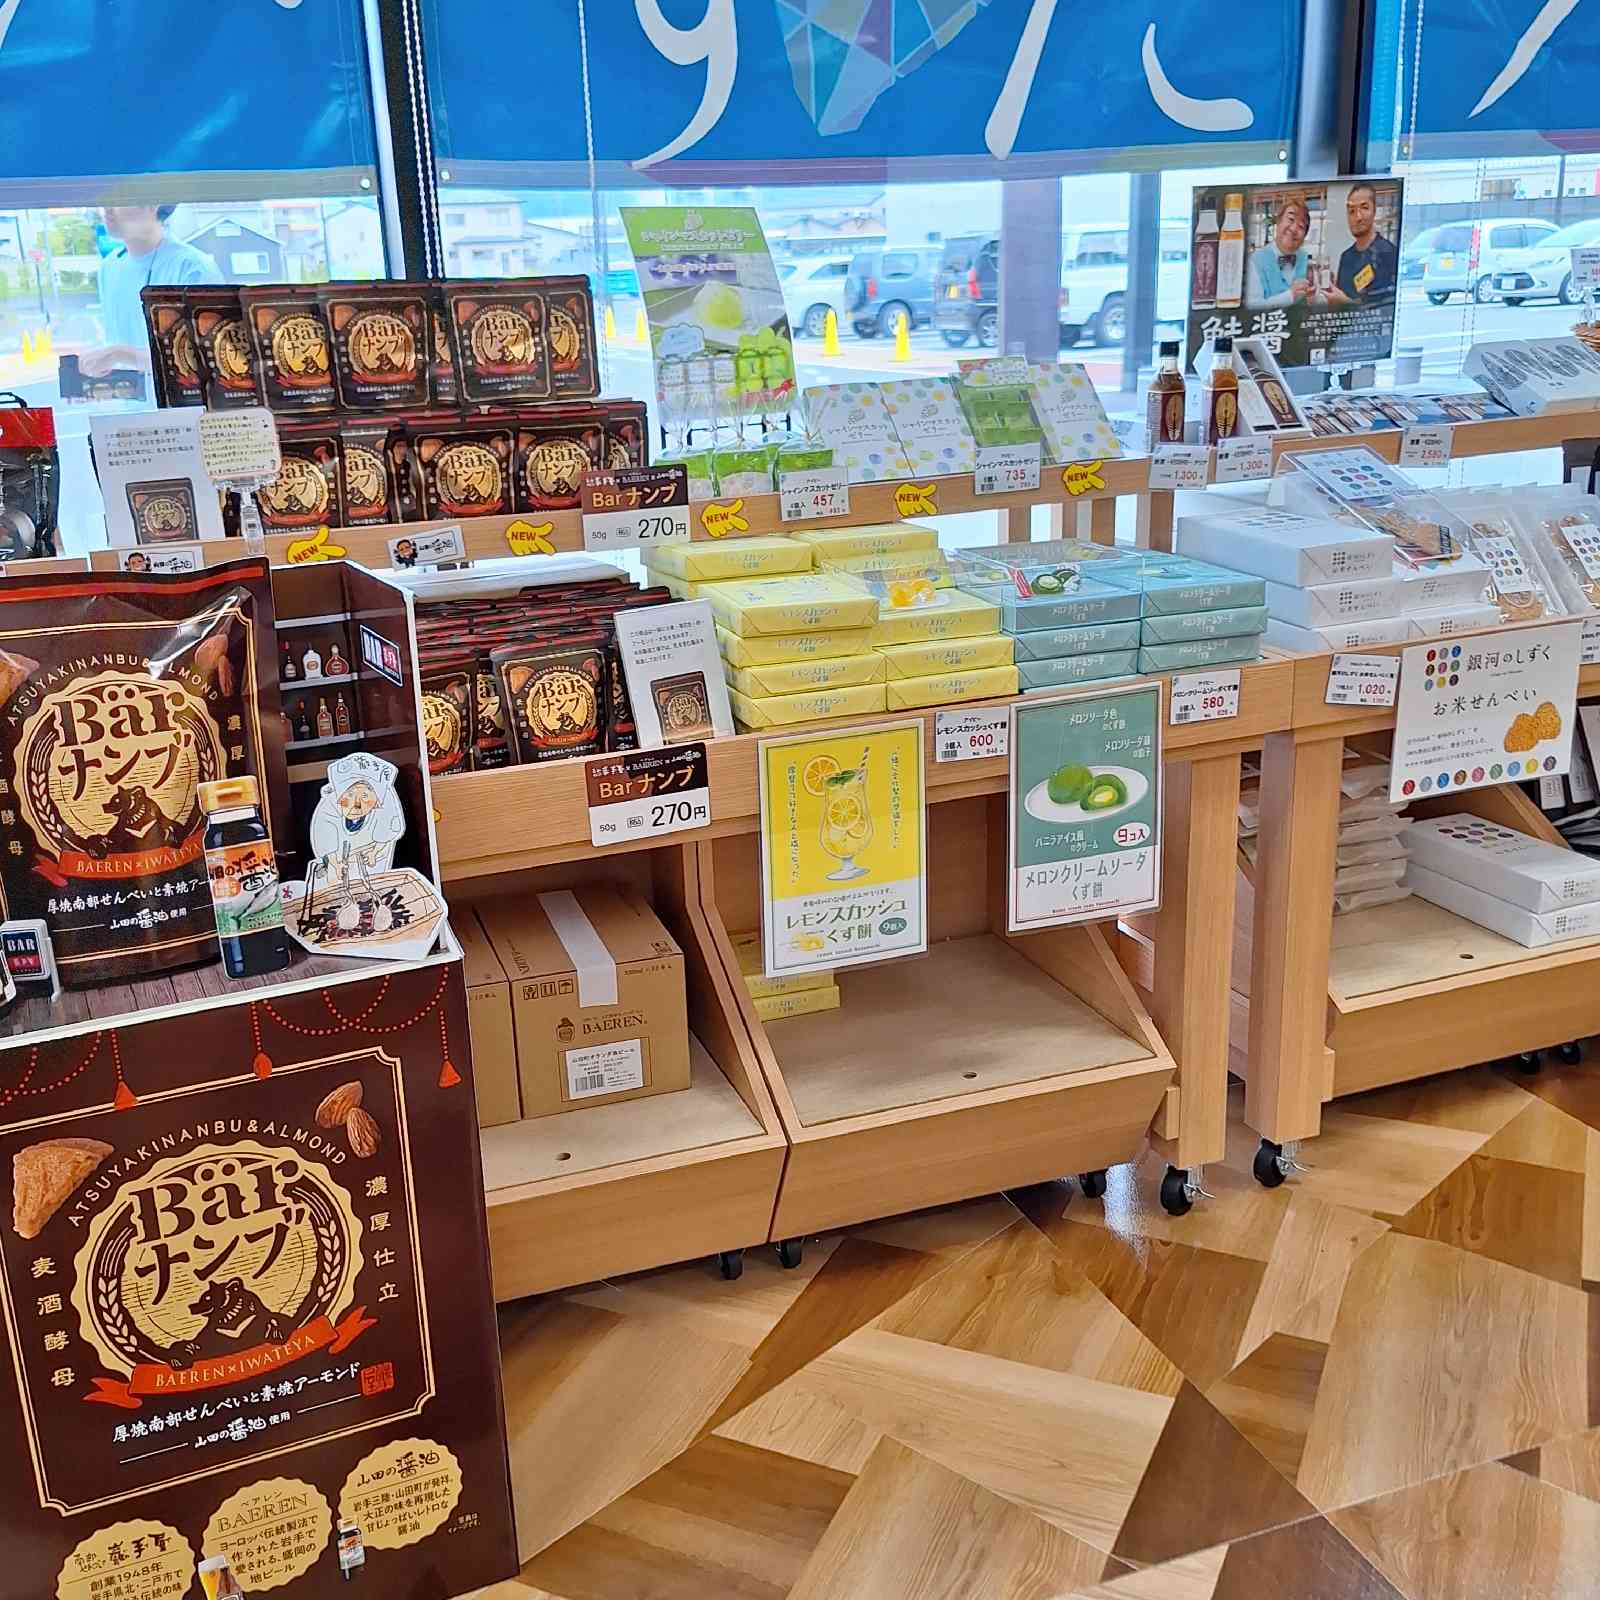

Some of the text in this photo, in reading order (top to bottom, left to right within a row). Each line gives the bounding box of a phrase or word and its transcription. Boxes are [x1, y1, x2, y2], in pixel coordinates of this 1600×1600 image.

[1006, 469, 1026, 481] 735
[1067, 470, 1089, 482] NEW
[592, 482, 678, 508] Bar ナンブ
[813, 494, 834, 506] 457
[898, 491, 920, 502] NEW
[592, 530, 607, 540] 50g
[638, 516, 687, 539] 270円
[705, 511, 730, 524] NEW
[510, 530, 539, 542] NEW
[293, 544, 320, 563] NEW
[1466, 643, 1551, 672] 銀河のしずく
[540, 677, 582, 699] Bär
[1202, 695, 1225, 710] 580
[1431, 687, 1537, 717] お米せんべい
[52, 685, 190, 749] Bär
[540, 693, 584, 718] ナンブ
[969, 733, 994, 747] 600
[58, 734, 192, 799] ナンブ
[599, 764, 696, 799] Bar ナンブ
[599, 823, 617, 832] 50g
[651, 801, 707, 827] 270円
[1117, 828, 1146, 843] 9コ入
[1025, 850, 1148, 888] メロンクリームソーダ
[1072, 881, 1103, 901] くず餅
[786, 899, 907, 930] レモンスカッシュ
[7, 938, 36, 952] BAR
[827, 922, 873, 943] くず餅
[582, 1014, 645, 1035] BAEREN
[68, 1119, 348, 1227] ATSUYAKINANBU&ALMOND
[129, 1157, 305, 1242] Bär
[364, 1175, 400, 1302] 濃厚仕立
[134, 1210, 306, 1306] ナンブ
[30, 1256, 76, 1388] 麦酒酵母
[112, 1361, 361, 1443] 厚焼南部せんべいと素焼アーモンド
[194, 1411, 291, 1449] 山田の醤油 使用
[357, 1450, 440, 1487] 山田の醤油
[216, 1492, 310, 1533] BAEREN
[363, 1487, 451, 1521] 大正の味を再現した
[219, 1515, 319, 1552] ヨーロッパ伝統製法で
[231, 1529, 317, 1562] 作られた岩手で
[90, 1561, 164, 1592] 創業1948年
[249, 1564, 296, 1584] 地ビール
